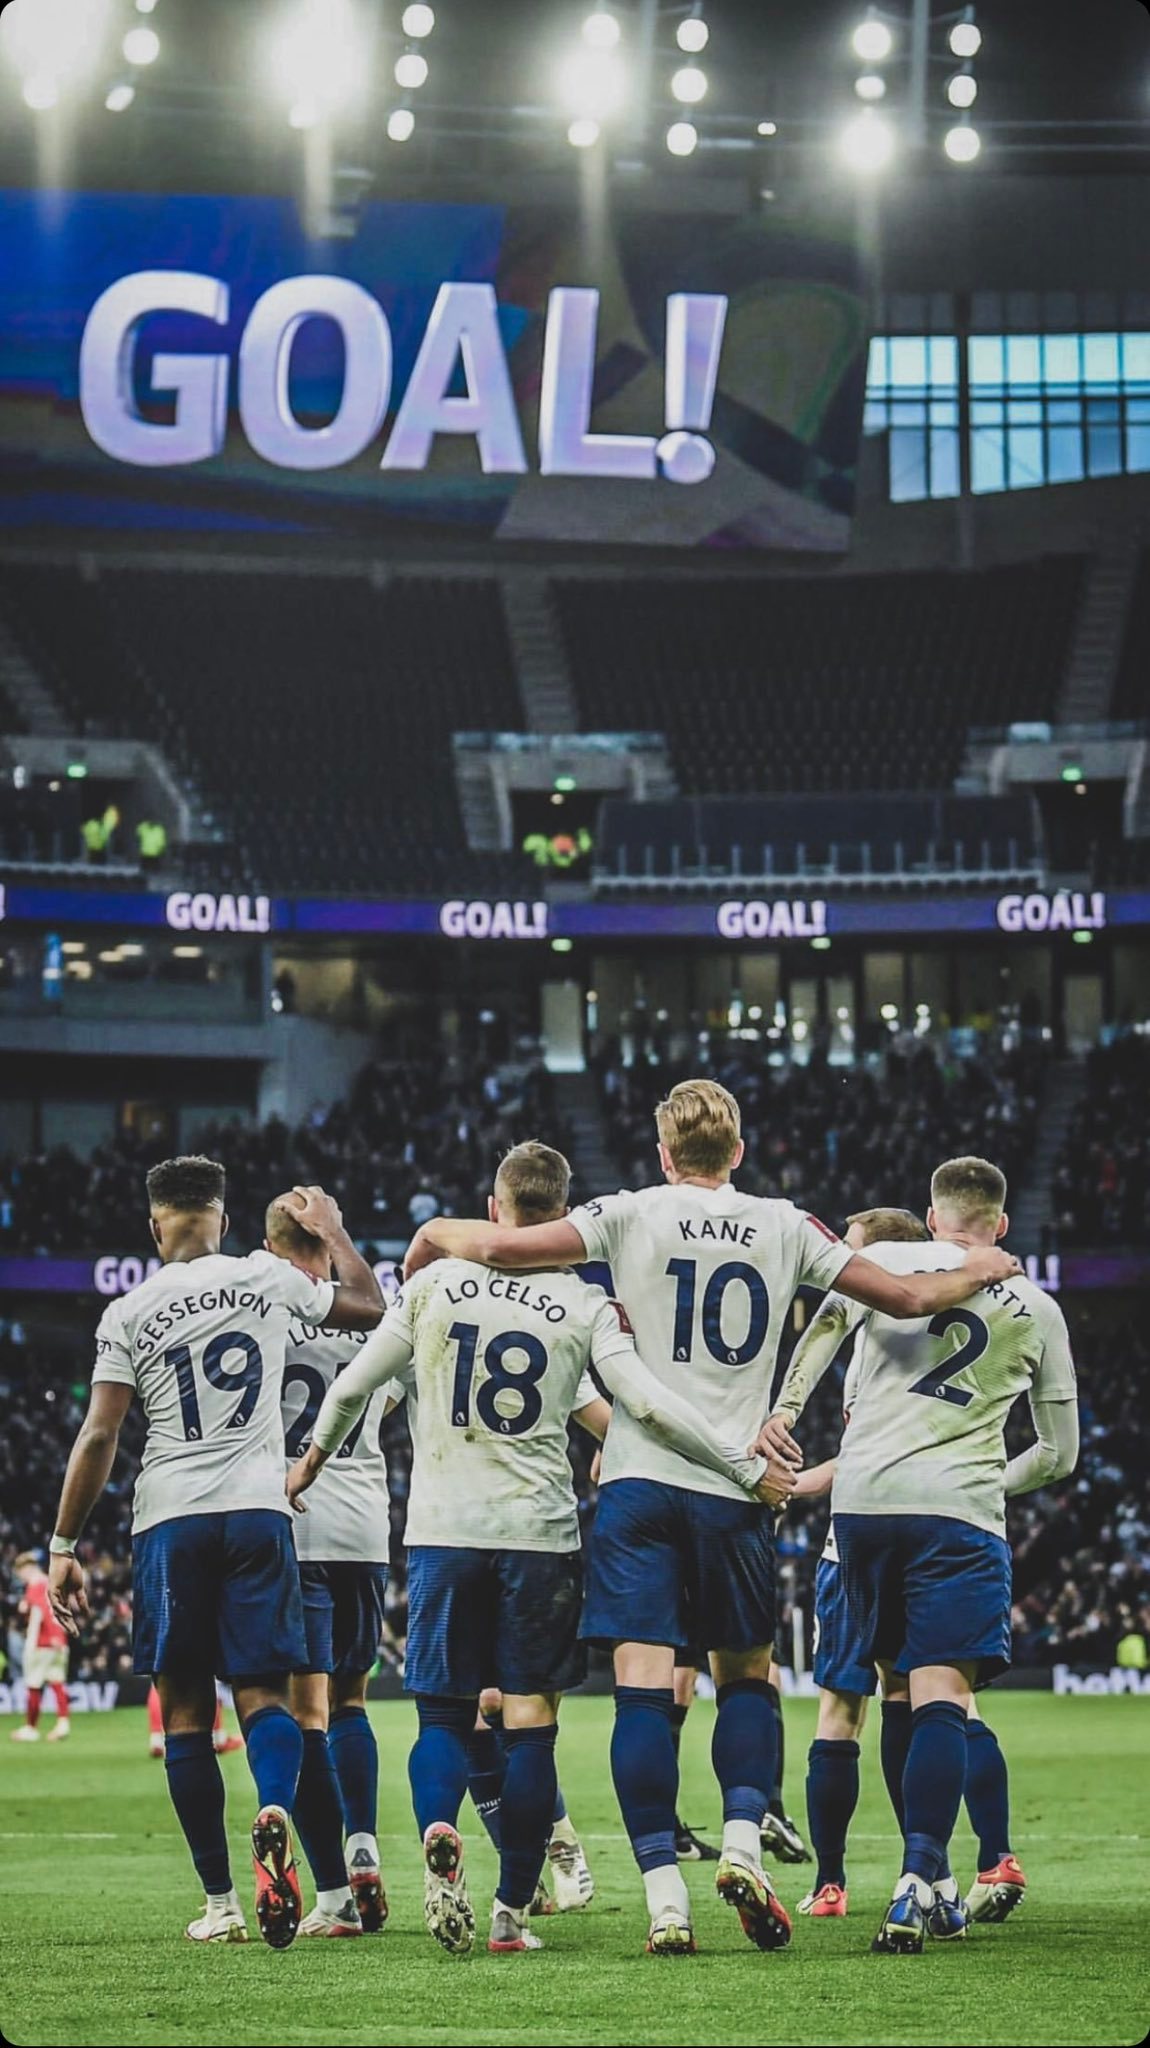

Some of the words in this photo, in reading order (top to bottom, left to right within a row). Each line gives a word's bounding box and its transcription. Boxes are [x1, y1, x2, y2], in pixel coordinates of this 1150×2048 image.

[79, 270, 728, 484] GOAL!
[166, 892, 270, 933] GOAL!
[440, 900, 548, 938] GOAL!
[717, 900, 826, 938] GOAL!
[997, 892, 1106, 931] GOAL!
[679, 1220, 757, 1247] KANE
[137, 1289, 272, 1352] SESSEGNON
[445, 1279, 479, 1304] LO
[489, 1279, 566, 1323] CELSO
[666, 1258, 769, 1366] 10
[288, 1322, 368, 1347] LUCAS
[447, 1321, 548, 1435] 18
[907, 1308, 988, 1407] 2
[164, 1331, 263, 1442] 19
